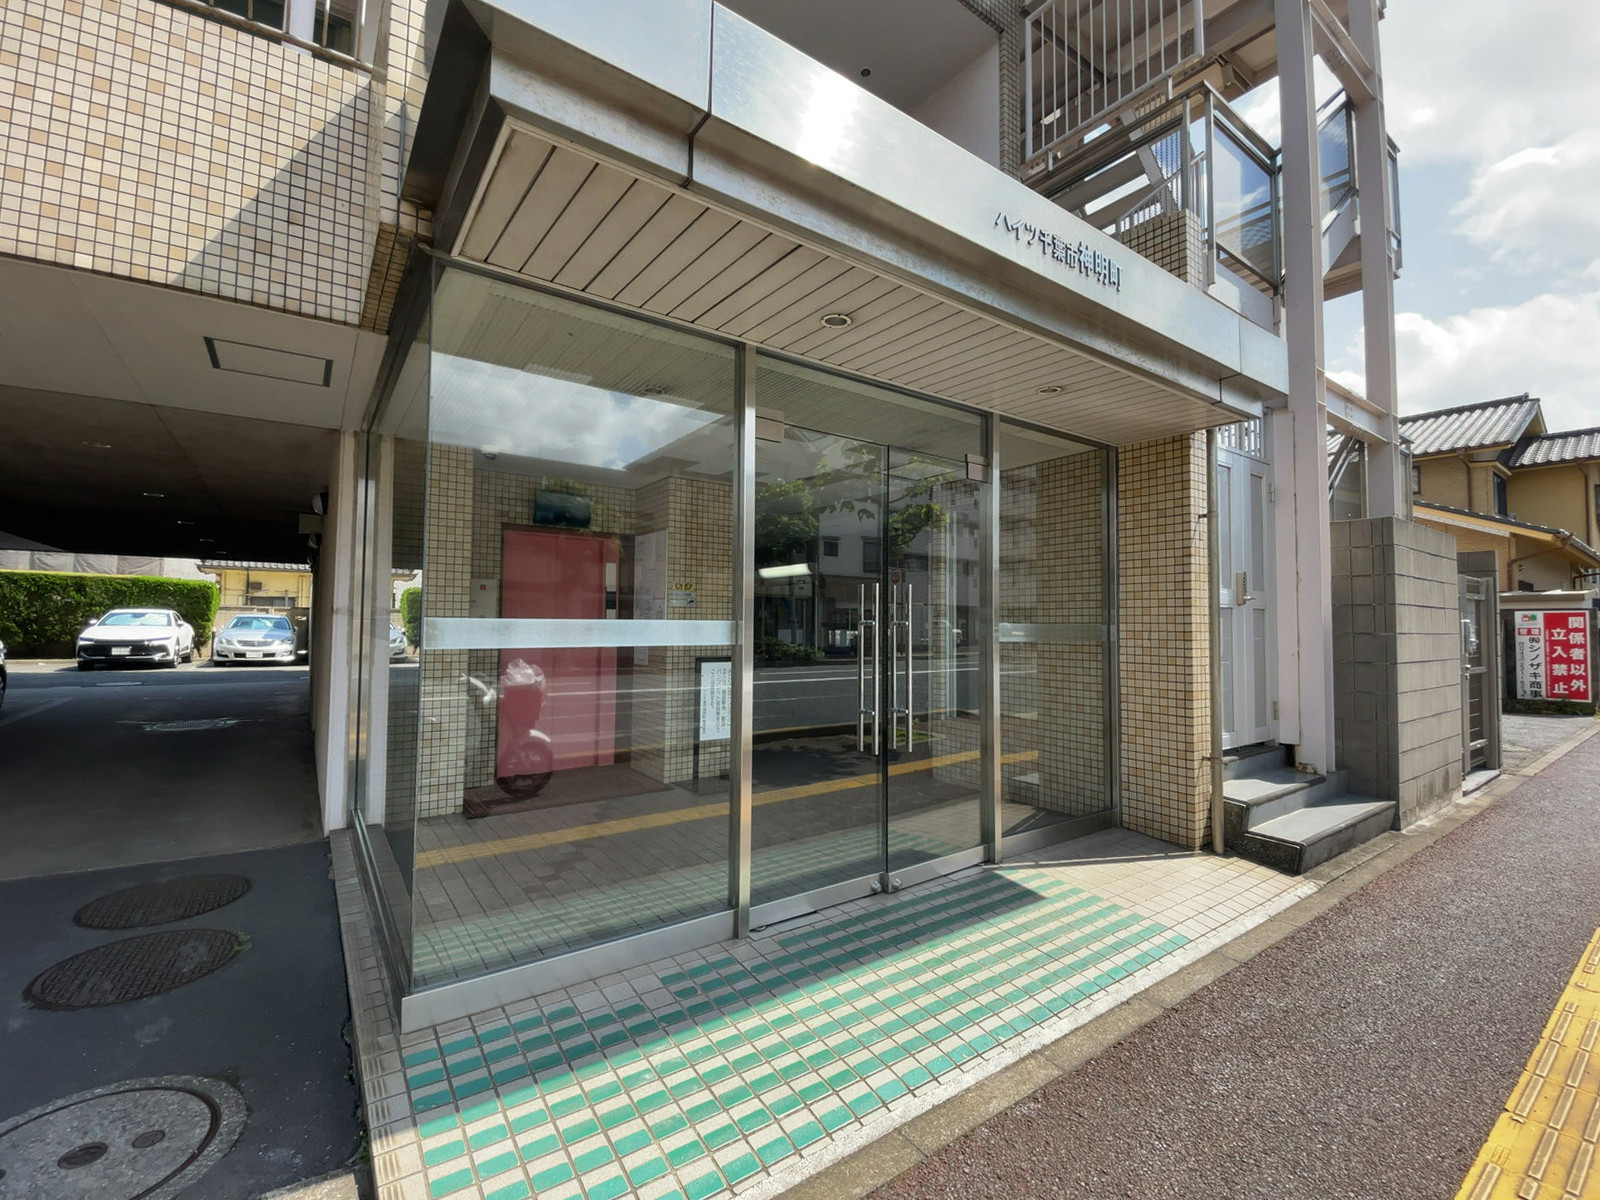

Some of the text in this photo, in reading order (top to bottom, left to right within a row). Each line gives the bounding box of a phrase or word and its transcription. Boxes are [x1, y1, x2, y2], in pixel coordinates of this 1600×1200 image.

[994, 211, 1123, 292] ハイツ千葉市神明町
[1551, 628, 1569, 694] 立入禁止
[1567, 616, 1586, 692] 関係者以外
